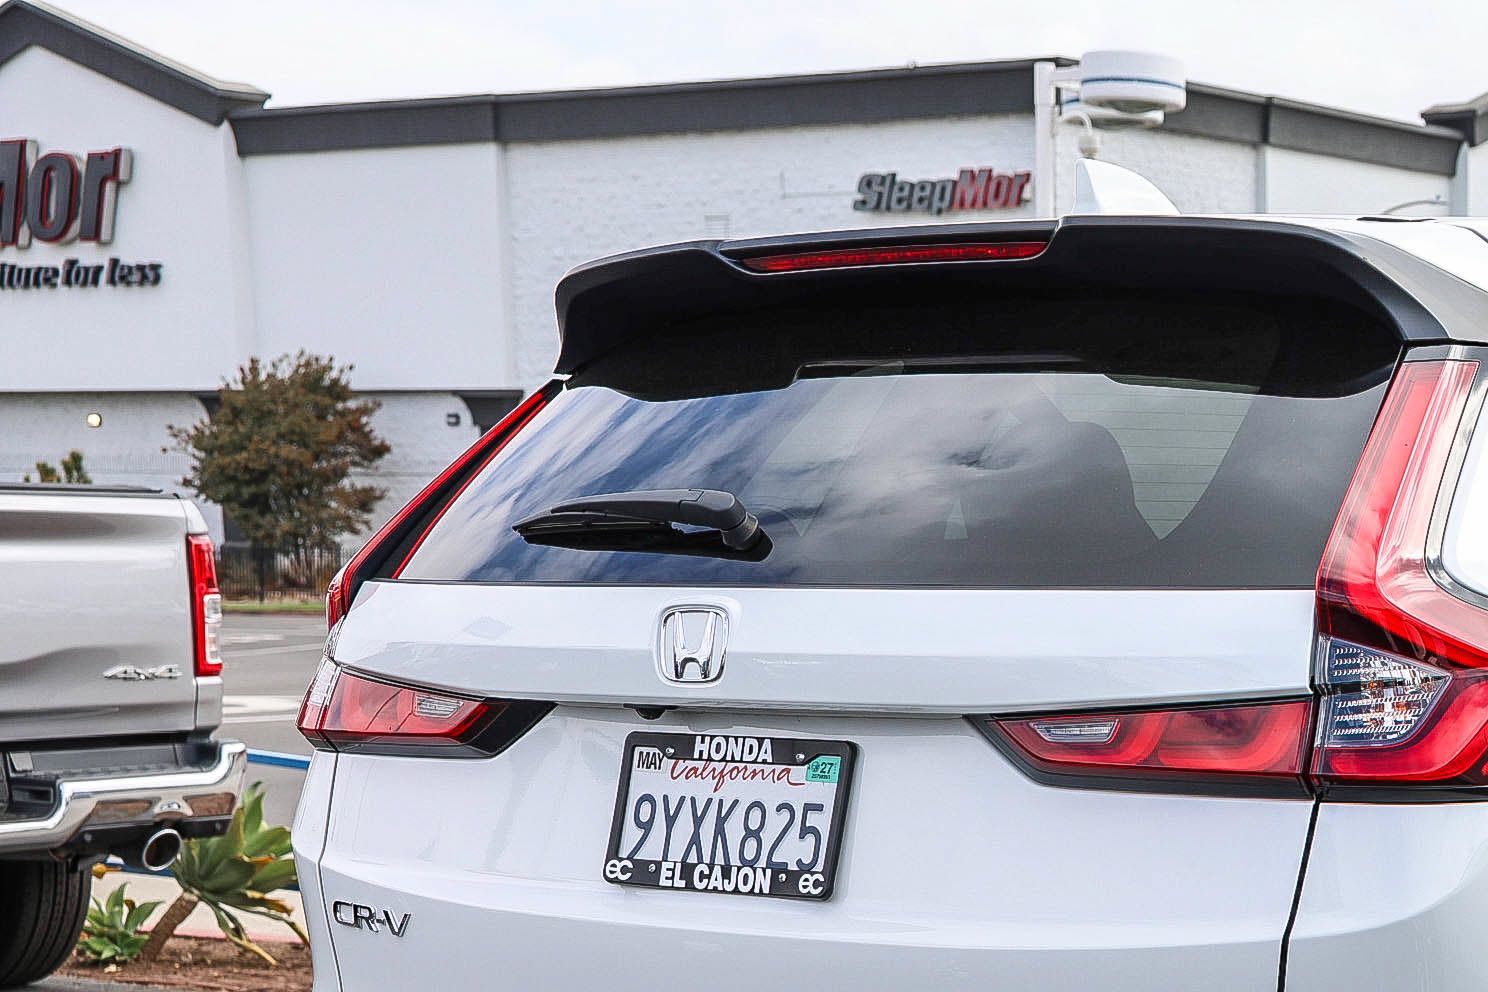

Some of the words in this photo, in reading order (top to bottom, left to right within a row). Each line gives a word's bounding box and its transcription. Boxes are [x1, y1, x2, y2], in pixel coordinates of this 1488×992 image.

[853, 168, 1031, 215] SleepMor
[62, 258, 104, 288] for
[106, 257, 163, 287] less
[637, 750, 665, 771] MAY
[693, 735, 772, 763] HONDA
[670, 758, 805, 793] California
[820, 761, 834, 776] 27
[627, 793, 824, 871] 9YXK825
[659, 861, 686, 888] EL
[693, 864, 772, 894] CAJON
[333, 900, 411, 937] CR-V
